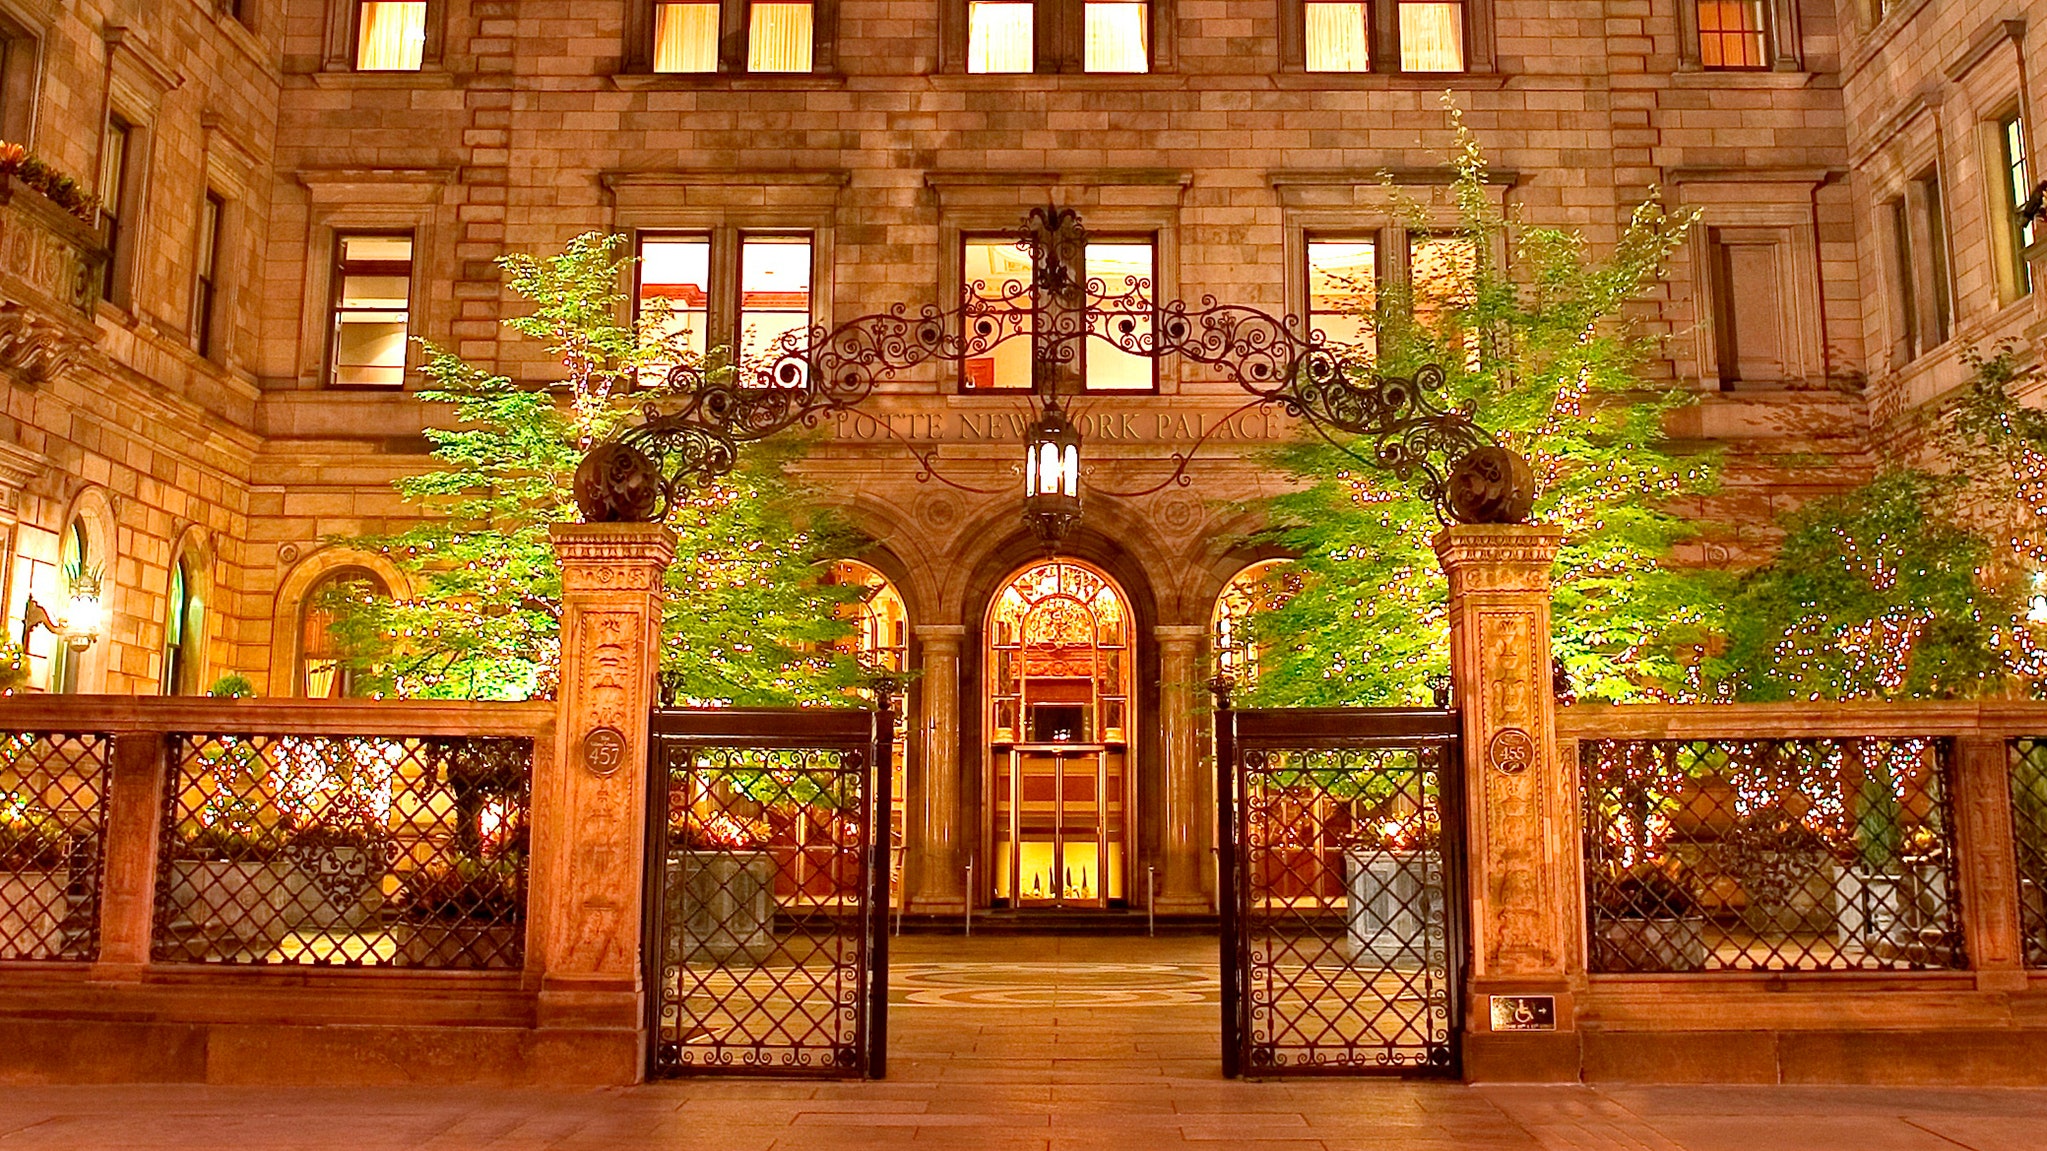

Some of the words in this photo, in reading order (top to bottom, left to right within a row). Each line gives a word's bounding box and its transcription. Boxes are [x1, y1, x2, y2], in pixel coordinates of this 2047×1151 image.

[835, 412, 944, 440] LOTTE
[1065, 412, 1140, 440] ORK
[1155, 412, 1282, 440] PALACE
[589, 747, 619, 765] 457
[1499, 746, 1525, 760] 455
